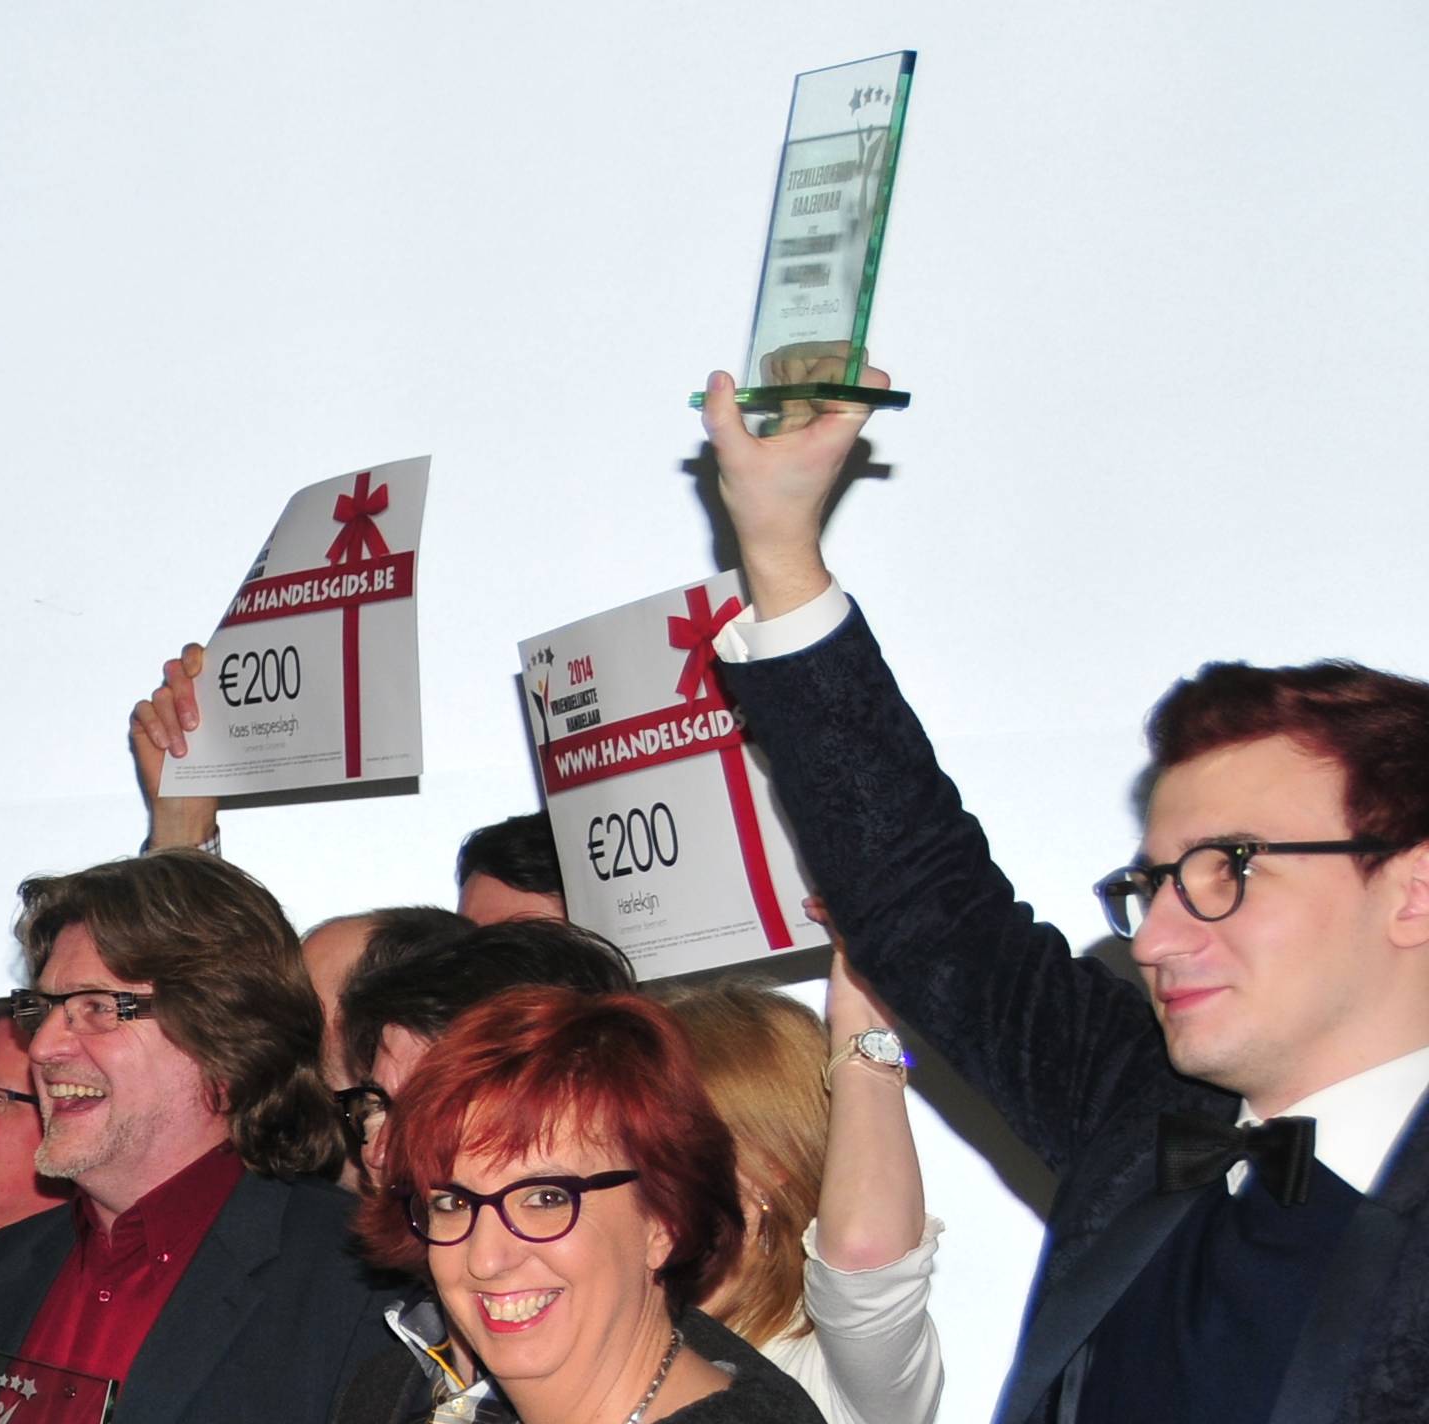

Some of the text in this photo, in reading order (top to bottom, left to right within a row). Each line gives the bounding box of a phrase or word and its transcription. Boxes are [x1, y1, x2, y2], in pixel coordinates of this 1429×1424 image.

[218, 645, 301, 707] €200
[567, 655, 594, 686] 2014
[587, 801, 679, 882] €200
